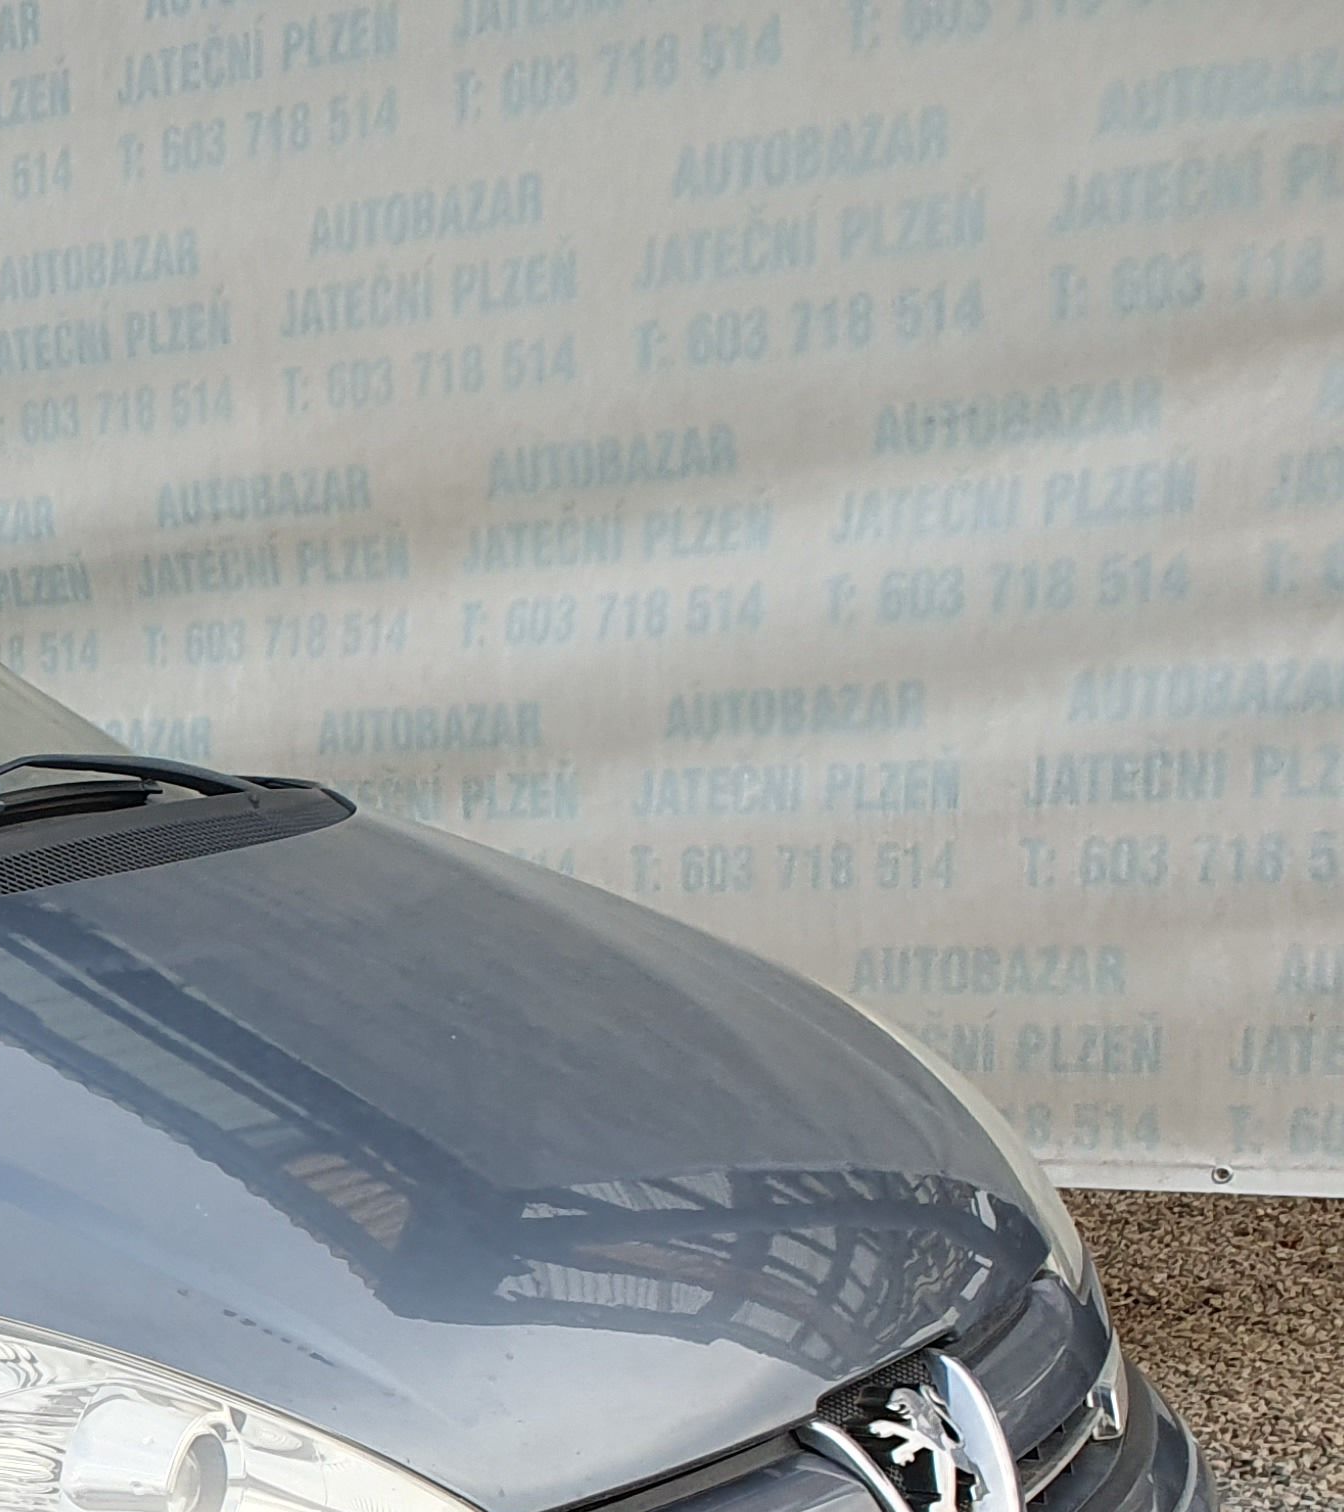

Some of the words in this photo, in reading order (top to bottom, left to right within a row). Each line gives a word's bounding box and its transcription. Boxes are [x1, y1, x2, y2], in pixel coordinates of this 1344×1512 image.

[117, 15, 263, 106] JATEČNÍ
[454, 68, 485, 127] T:
[501, 51, 579, 121] 603
[596, 32, 680, 96] 718
[700, 12, 781, 81] 514
[13, 144, 72, 200] 514
[118, 133, 144, 184] T:
[161, 117, 227, 175] 603
[246, 102, 311, 160] 718
[329, 84, 400, 145] 514
[671, 103, 950, 199] AUTOBAZAR
[308, 170, 544, 262] AUTOBAZAR
[1049, 135, 1266, 238] JATEČNÍ
[632, 203, 816, 295] JATEČNÍ
[839, 172, 989, 262] PLZEŇ
[280, 259, 433, 337] JATEČNÍ
[451, 233, 578, 317] PLZEŇ
[1112, 250, 1204, 312] 603
[125, 283, 231, 358] PLZEŇ
[632, 318, 674, 375] T:
[685, 305, 769, 368] 603
[790, 291, 874, 357] 718
[892, 276, 983, 341] 514
[20, 394, 81, 446] 603
[96, 384, 156, 434] 718
[171, 375, 233, 430] 514
[282, 367, 310, 414] T:
[326, 357, 394, 410] 603
[414, 343, 486, 399] 718
[501, 332, 576, 392] 514
[872, 374, 1163, 456] AUTOBAZAR
[157, 464, 372, 529] AUTOBAZAR
[488, 421, 737, 500] AUTOBAZAR
[828, 465, 1020, 548] JATEČNÍ
[1043, 443, 1197, 528] PLZEŇ
[138, 531, 281, 599] JATEČNÍ
[296, 518, 409, 587] PLZEŇ
[463, 498, 626, 572] JATEČNÍ
[643, 482, 775, 559] PLZEŇ
[461, 600, 489, 650] T:
[505, 596, 577, 647] 603
[596, 588, 669, 642] 718
[686, 580, 767, 635] 514
[827, 571, 856, 626] T:
[877, 566, 965, 623] 603
[988, 558, 1076, 615] 718
[1096, 550, 1191, 609] 514
[41, 628, 99, 671] 514
[143, 623, 167, 668] T:
[185, 618, 246, 667] 603
[265, 612, 328, 659] 718
[342, 607, 408, 656] 514
[317, 699, 543, 756] AUTOBAZAR
[664, 678, 927, 742] AUTOBAZAR
[462, 757, 579, 819] PLZEŇ
[631, 761, 802, 818] JATEČNÍ
[824, 745, 959, 812] PLZEŇ
[1022, 730, 1230, 808] JATEČNÍ
[631, 844, 661, 891] T:
[680, 843, 754, 894] 603
[778, 840, 855, 890] 718
[875, 839, 954, 891] 514
[1019, 837, 1055, 888] T:
[1079, 834, 1168, 887] 603
[1192, 830, 1286, 884] 718
[850, 943, 1126, 995] AUTOBAZAR
[1015, 1011, 1163, 1074] PLZEŇ
